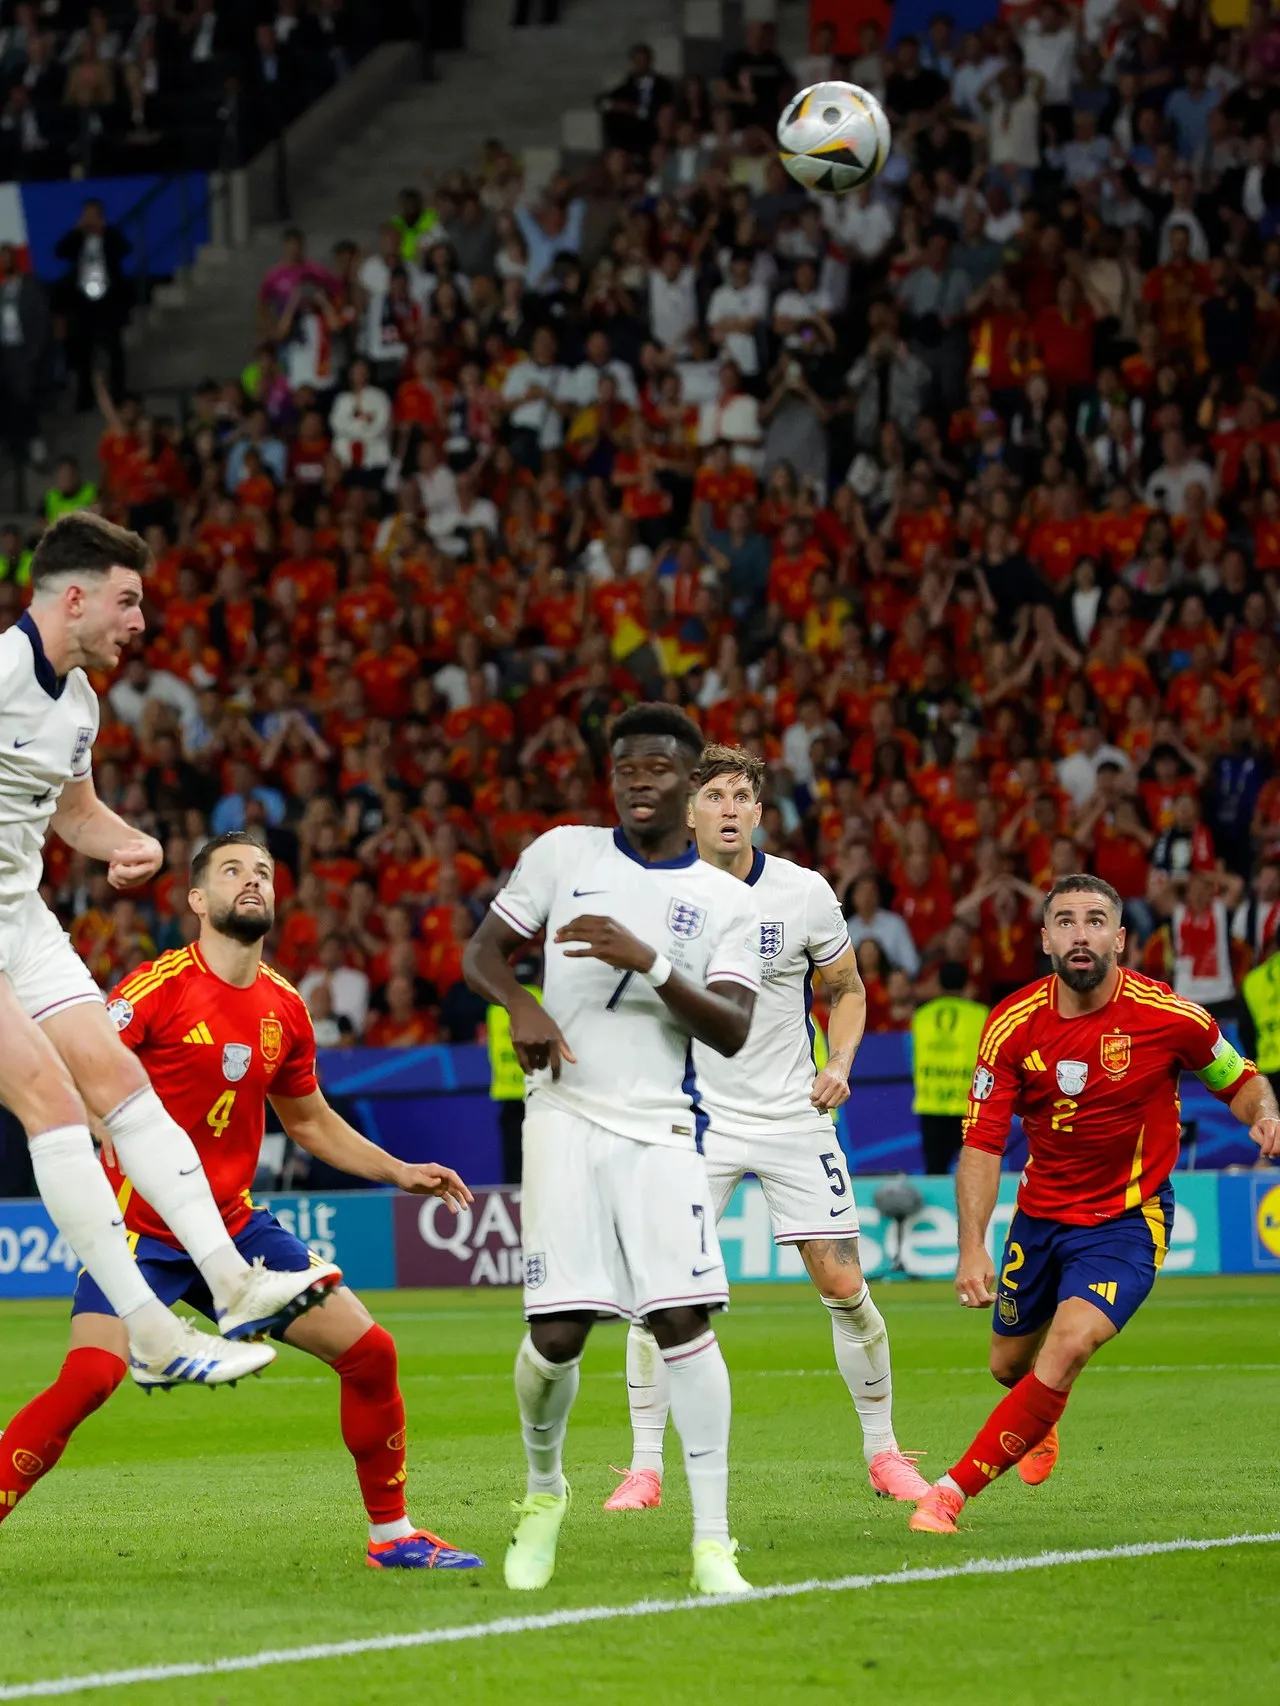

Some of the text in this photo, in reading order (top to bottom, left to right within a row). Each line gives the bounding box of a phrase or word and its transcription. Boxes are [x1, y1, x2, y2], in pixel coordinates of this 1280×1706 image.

[206, 1089, 237, 1138] 4
[1051, 1098, 1079, 1133] 2
[818, 1152, 847, 1198] 5
[418, 1191, 522, 1262] QA
[691, 1204, 709, 1256] 7
[1001, 1241, 1025, 1291] 2
